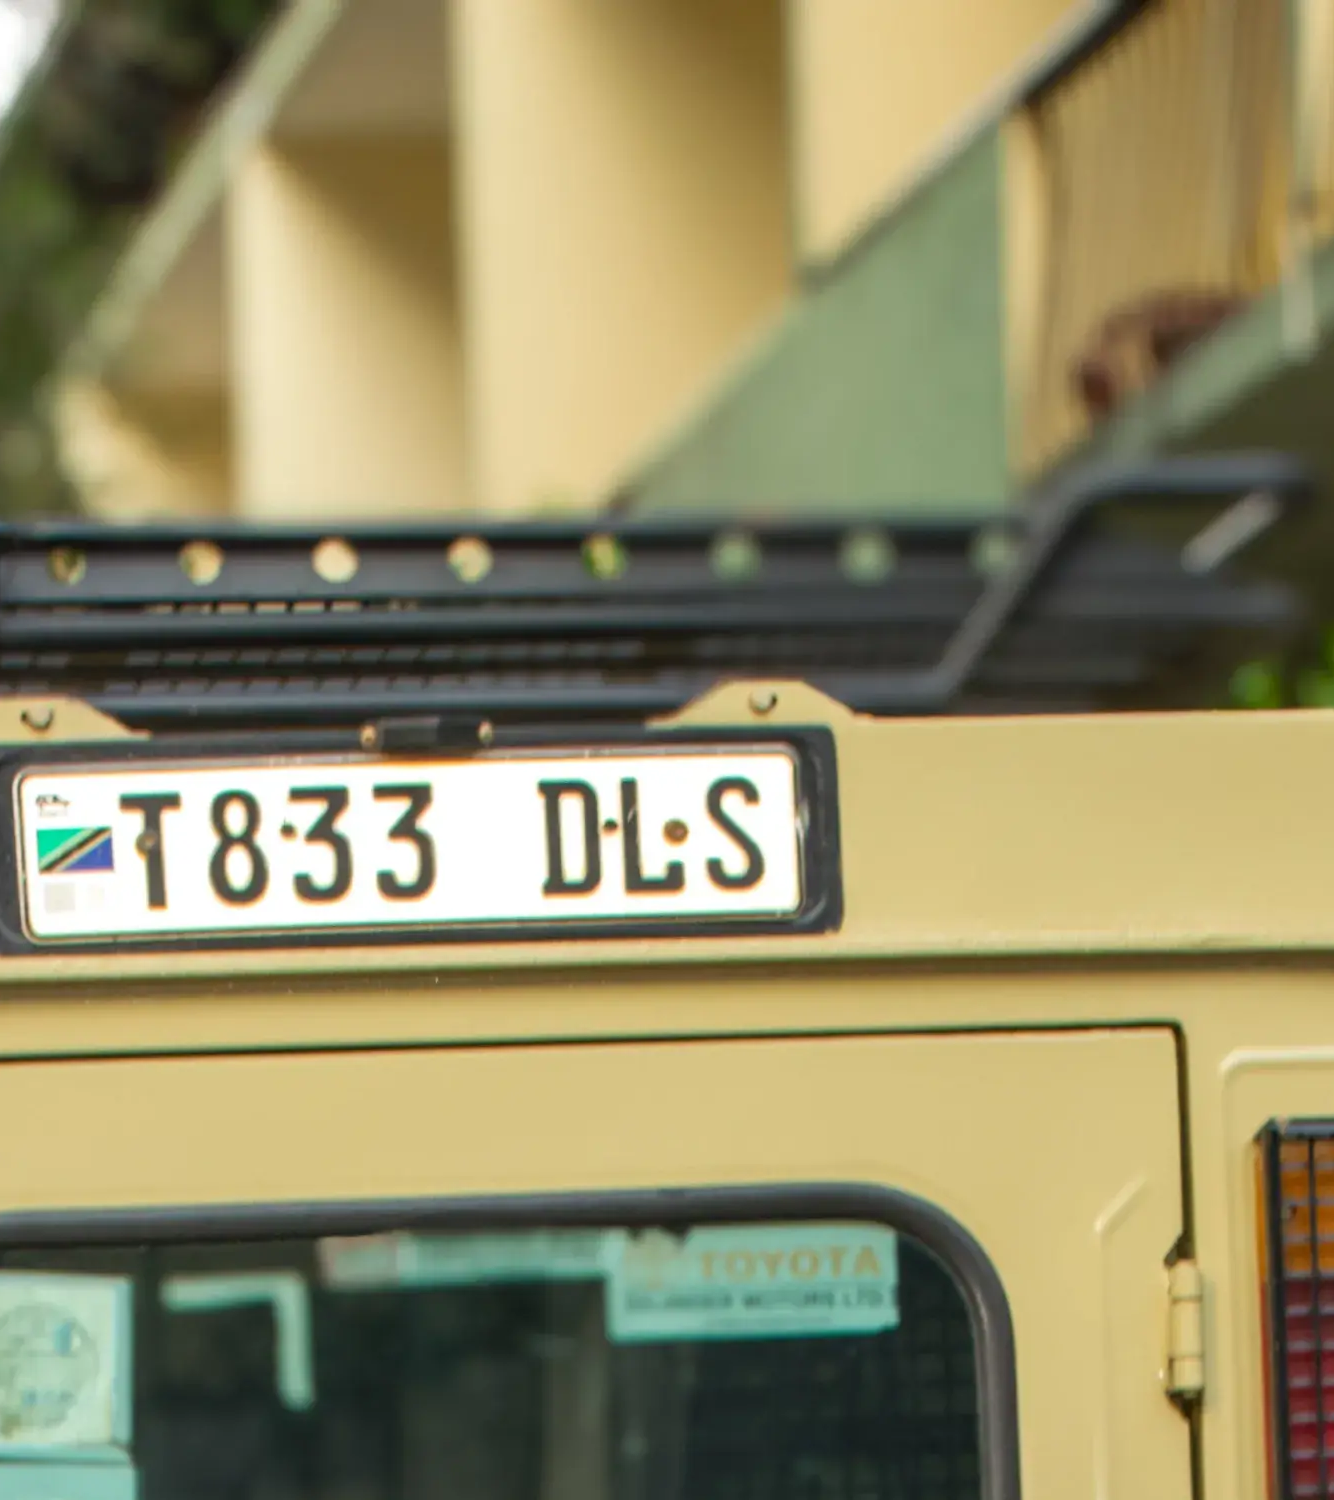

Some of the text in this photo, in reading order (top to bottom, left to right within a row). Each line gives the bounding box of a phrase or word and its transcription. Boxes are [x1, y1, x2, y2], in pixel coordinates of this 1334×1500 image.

[119, 776, 766, 910] T833 DLS
[700, 1246, 882, 1282] TOYOTA
